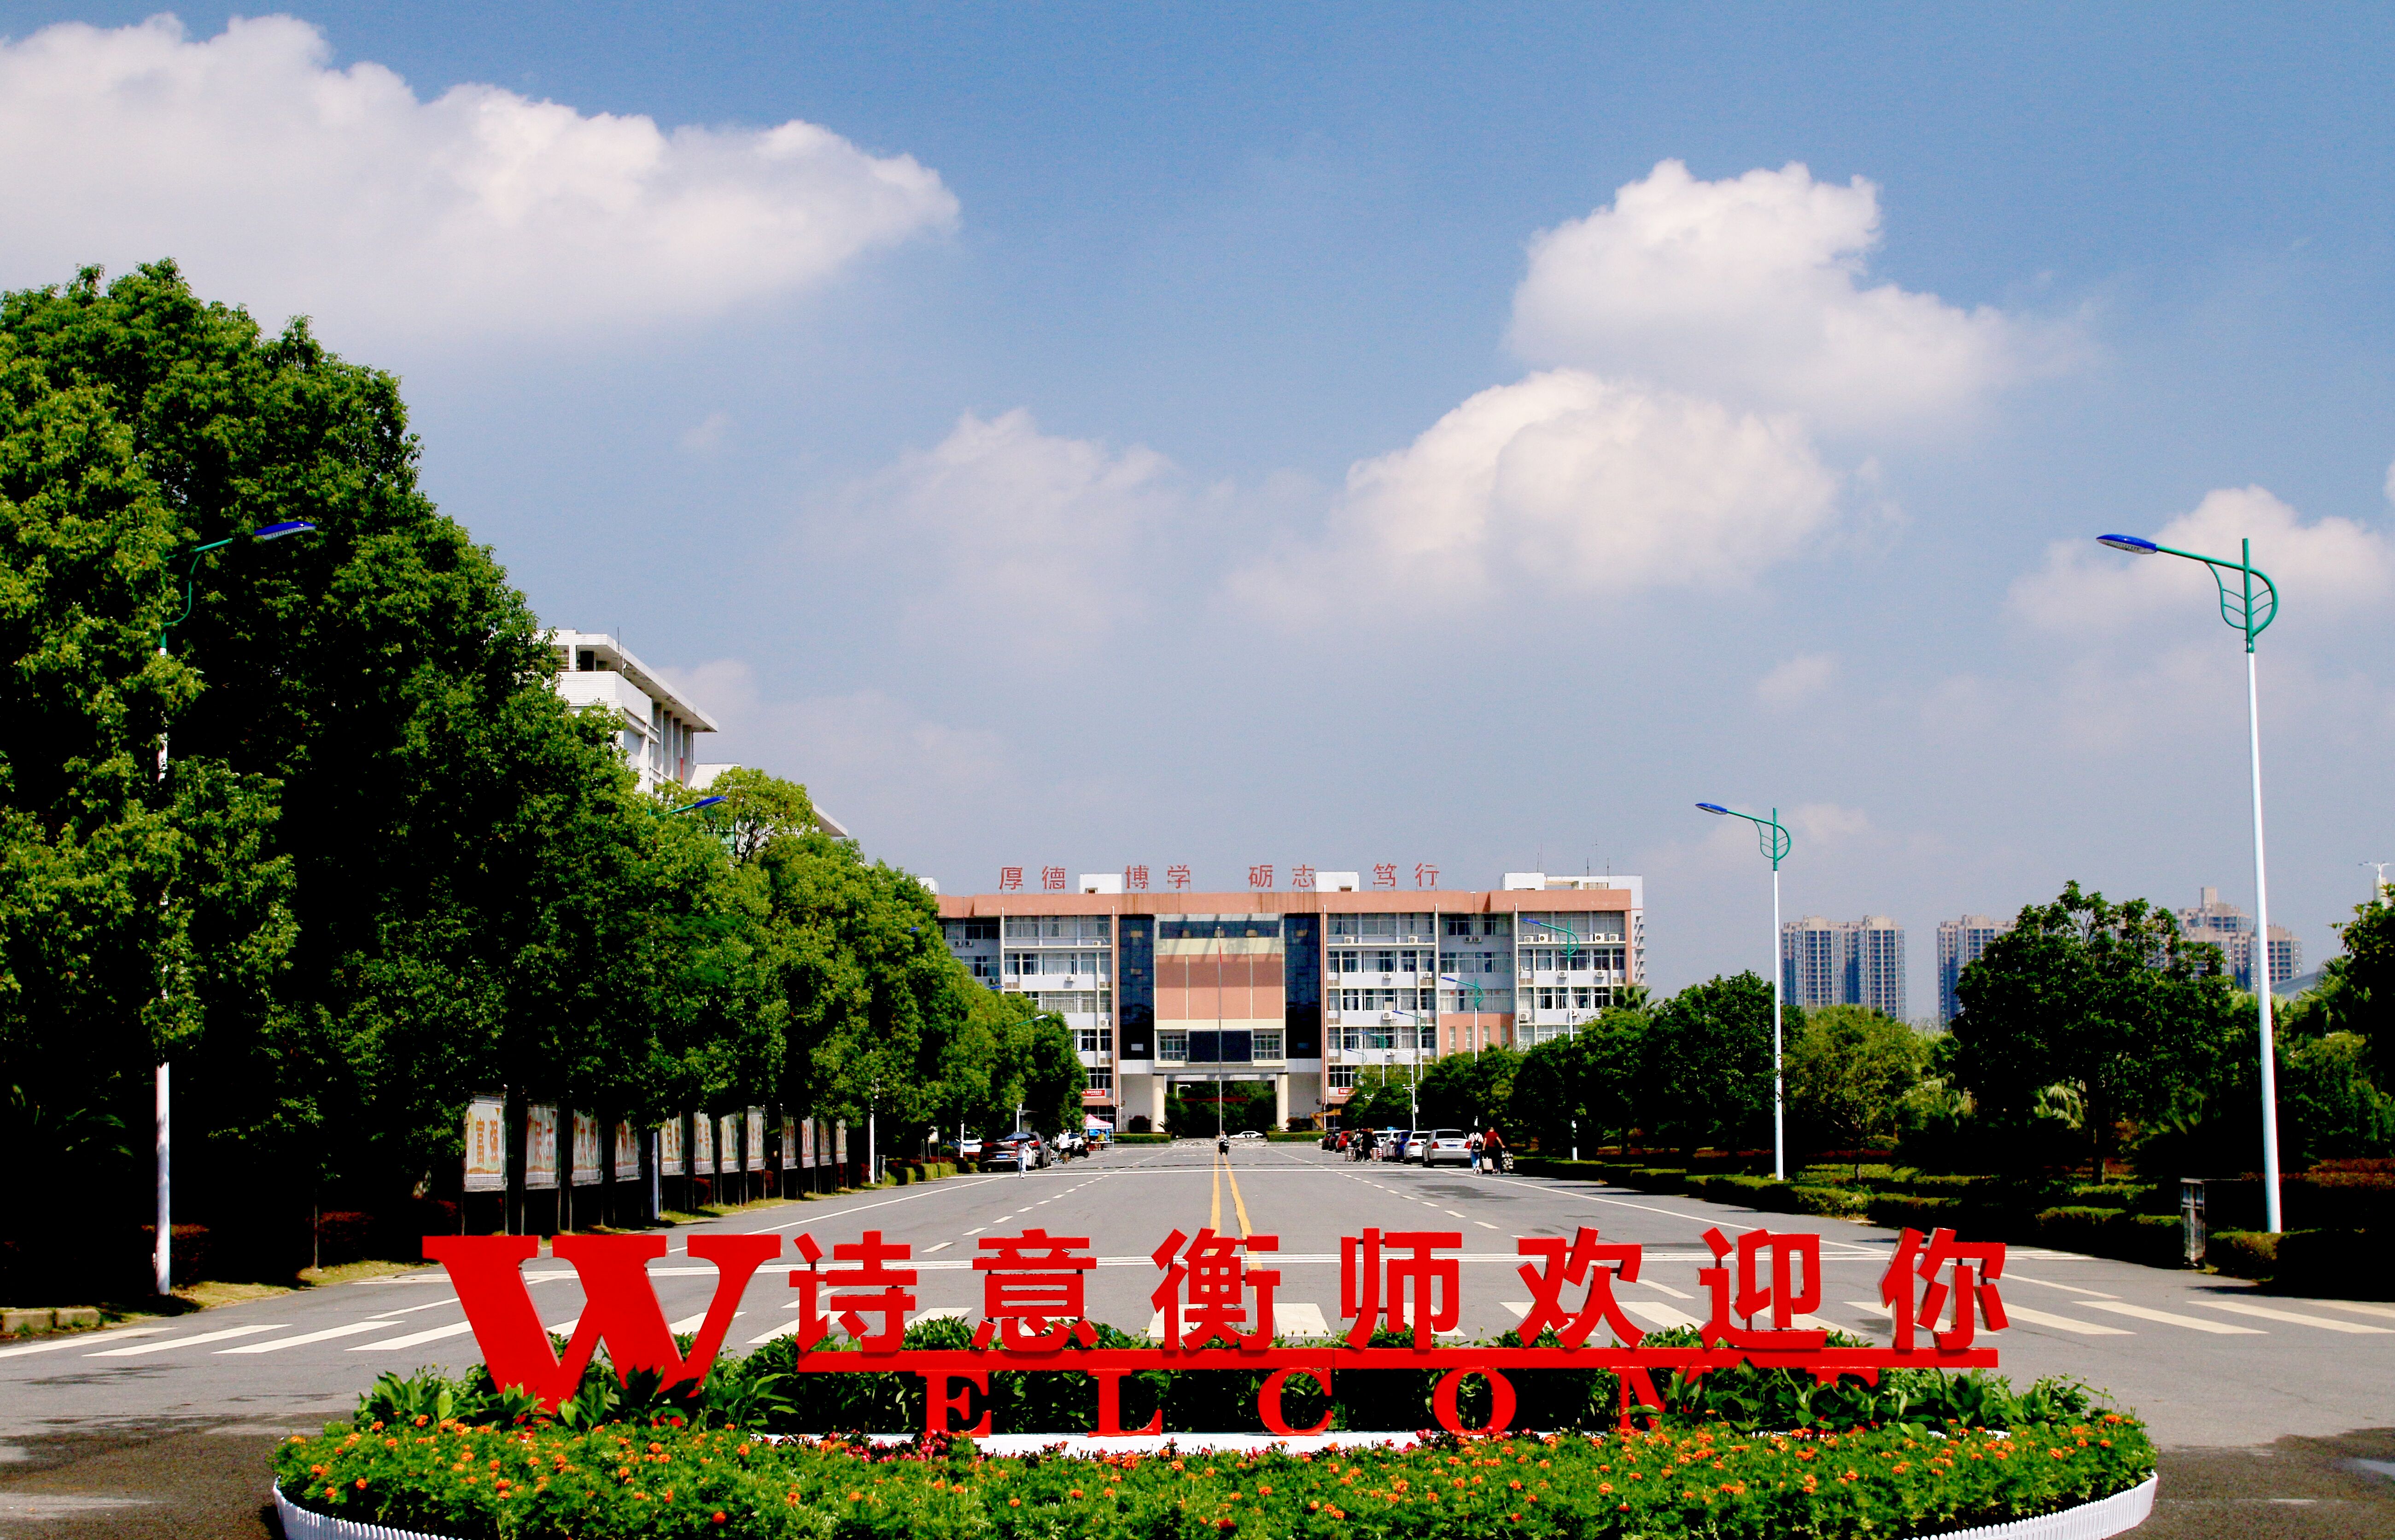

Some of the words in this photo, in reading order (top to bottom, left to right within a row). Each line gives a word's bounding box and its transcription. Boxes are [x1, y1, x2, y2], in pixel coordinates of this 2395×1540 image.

[999, 865, 1065, 890] 厚德
[1125, 864, 1190, 889] 博学
[1248, 864, 1314, 887] 砺志
[1373, 863, 1439, 887] 笃行
[789, 1227, 2009, 1353] 诗意衡师欢迎你
